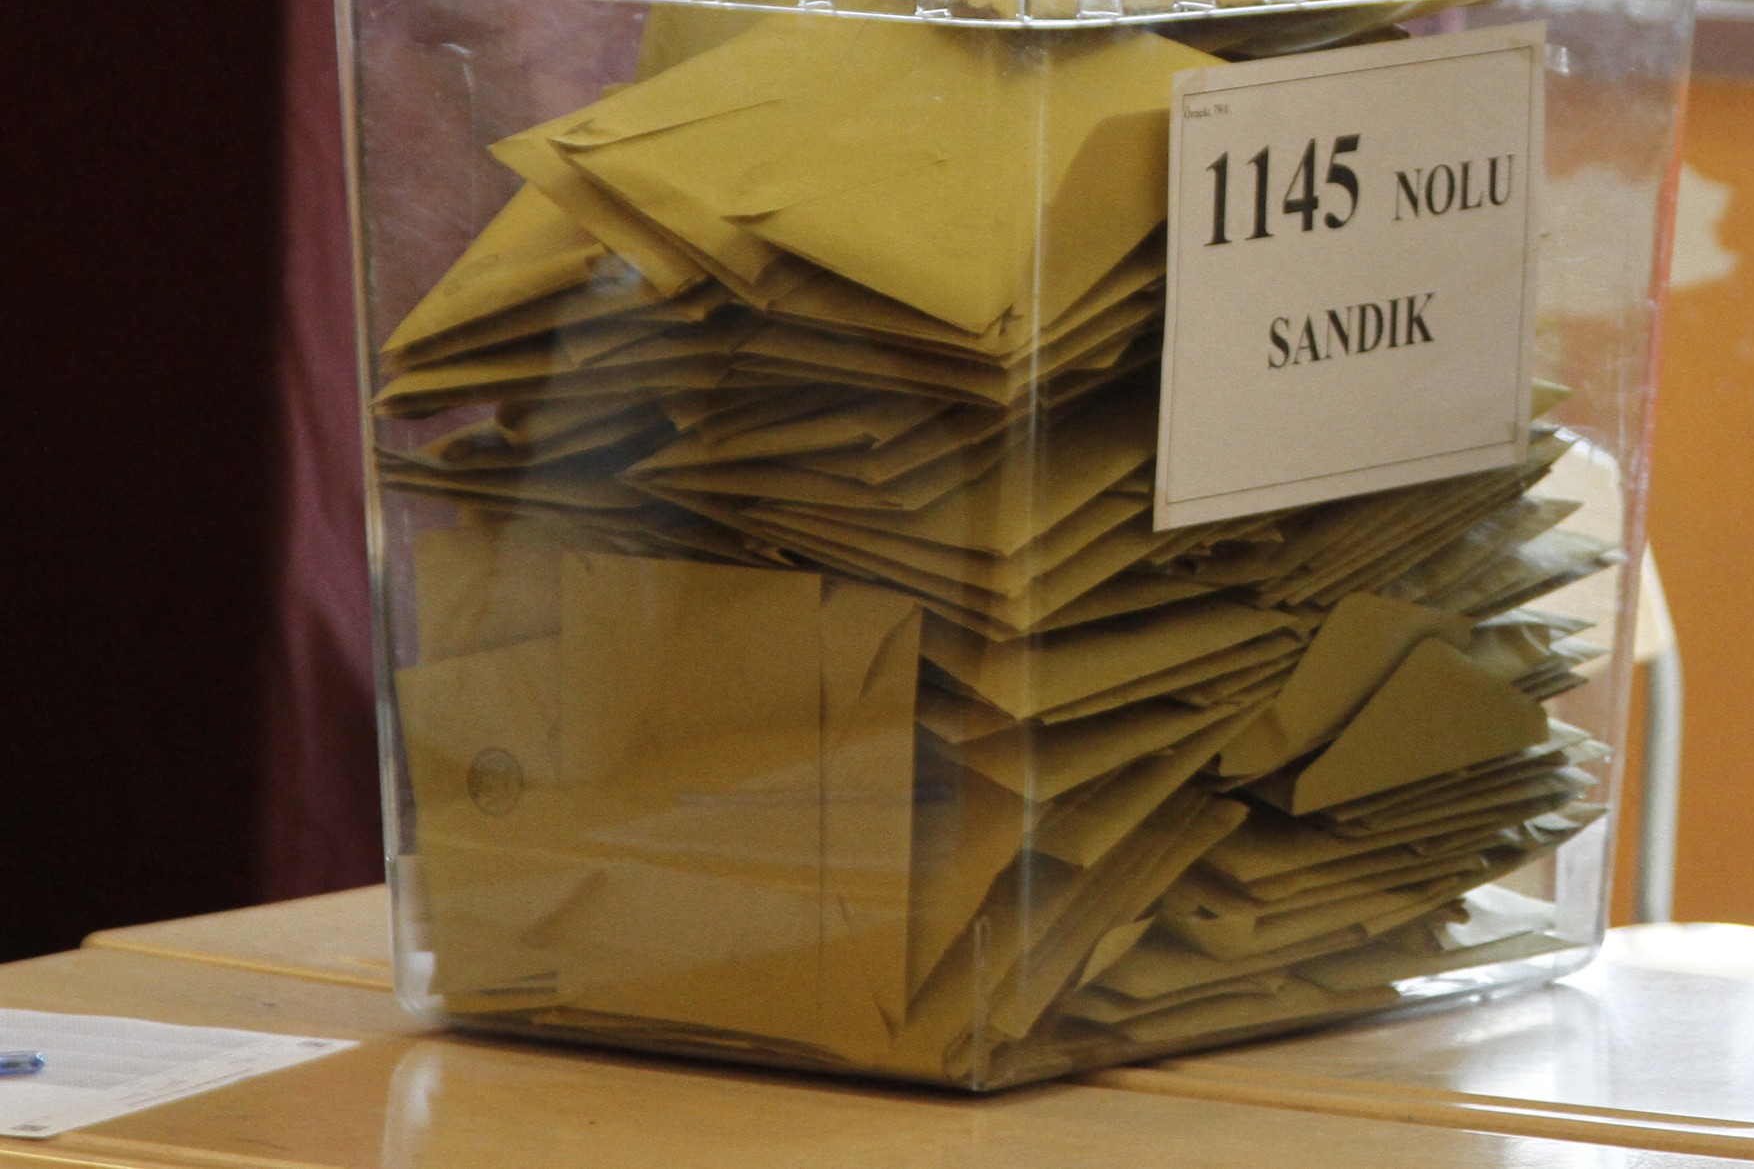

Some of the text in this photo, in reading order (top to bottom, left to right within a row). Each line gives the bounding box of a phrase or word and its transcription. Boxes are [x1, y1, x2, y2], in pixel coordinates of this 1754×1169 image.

[1203, 134, 1515, 246] 1145 NOLU
[1267, 292, 1436, 369] SANDIK
